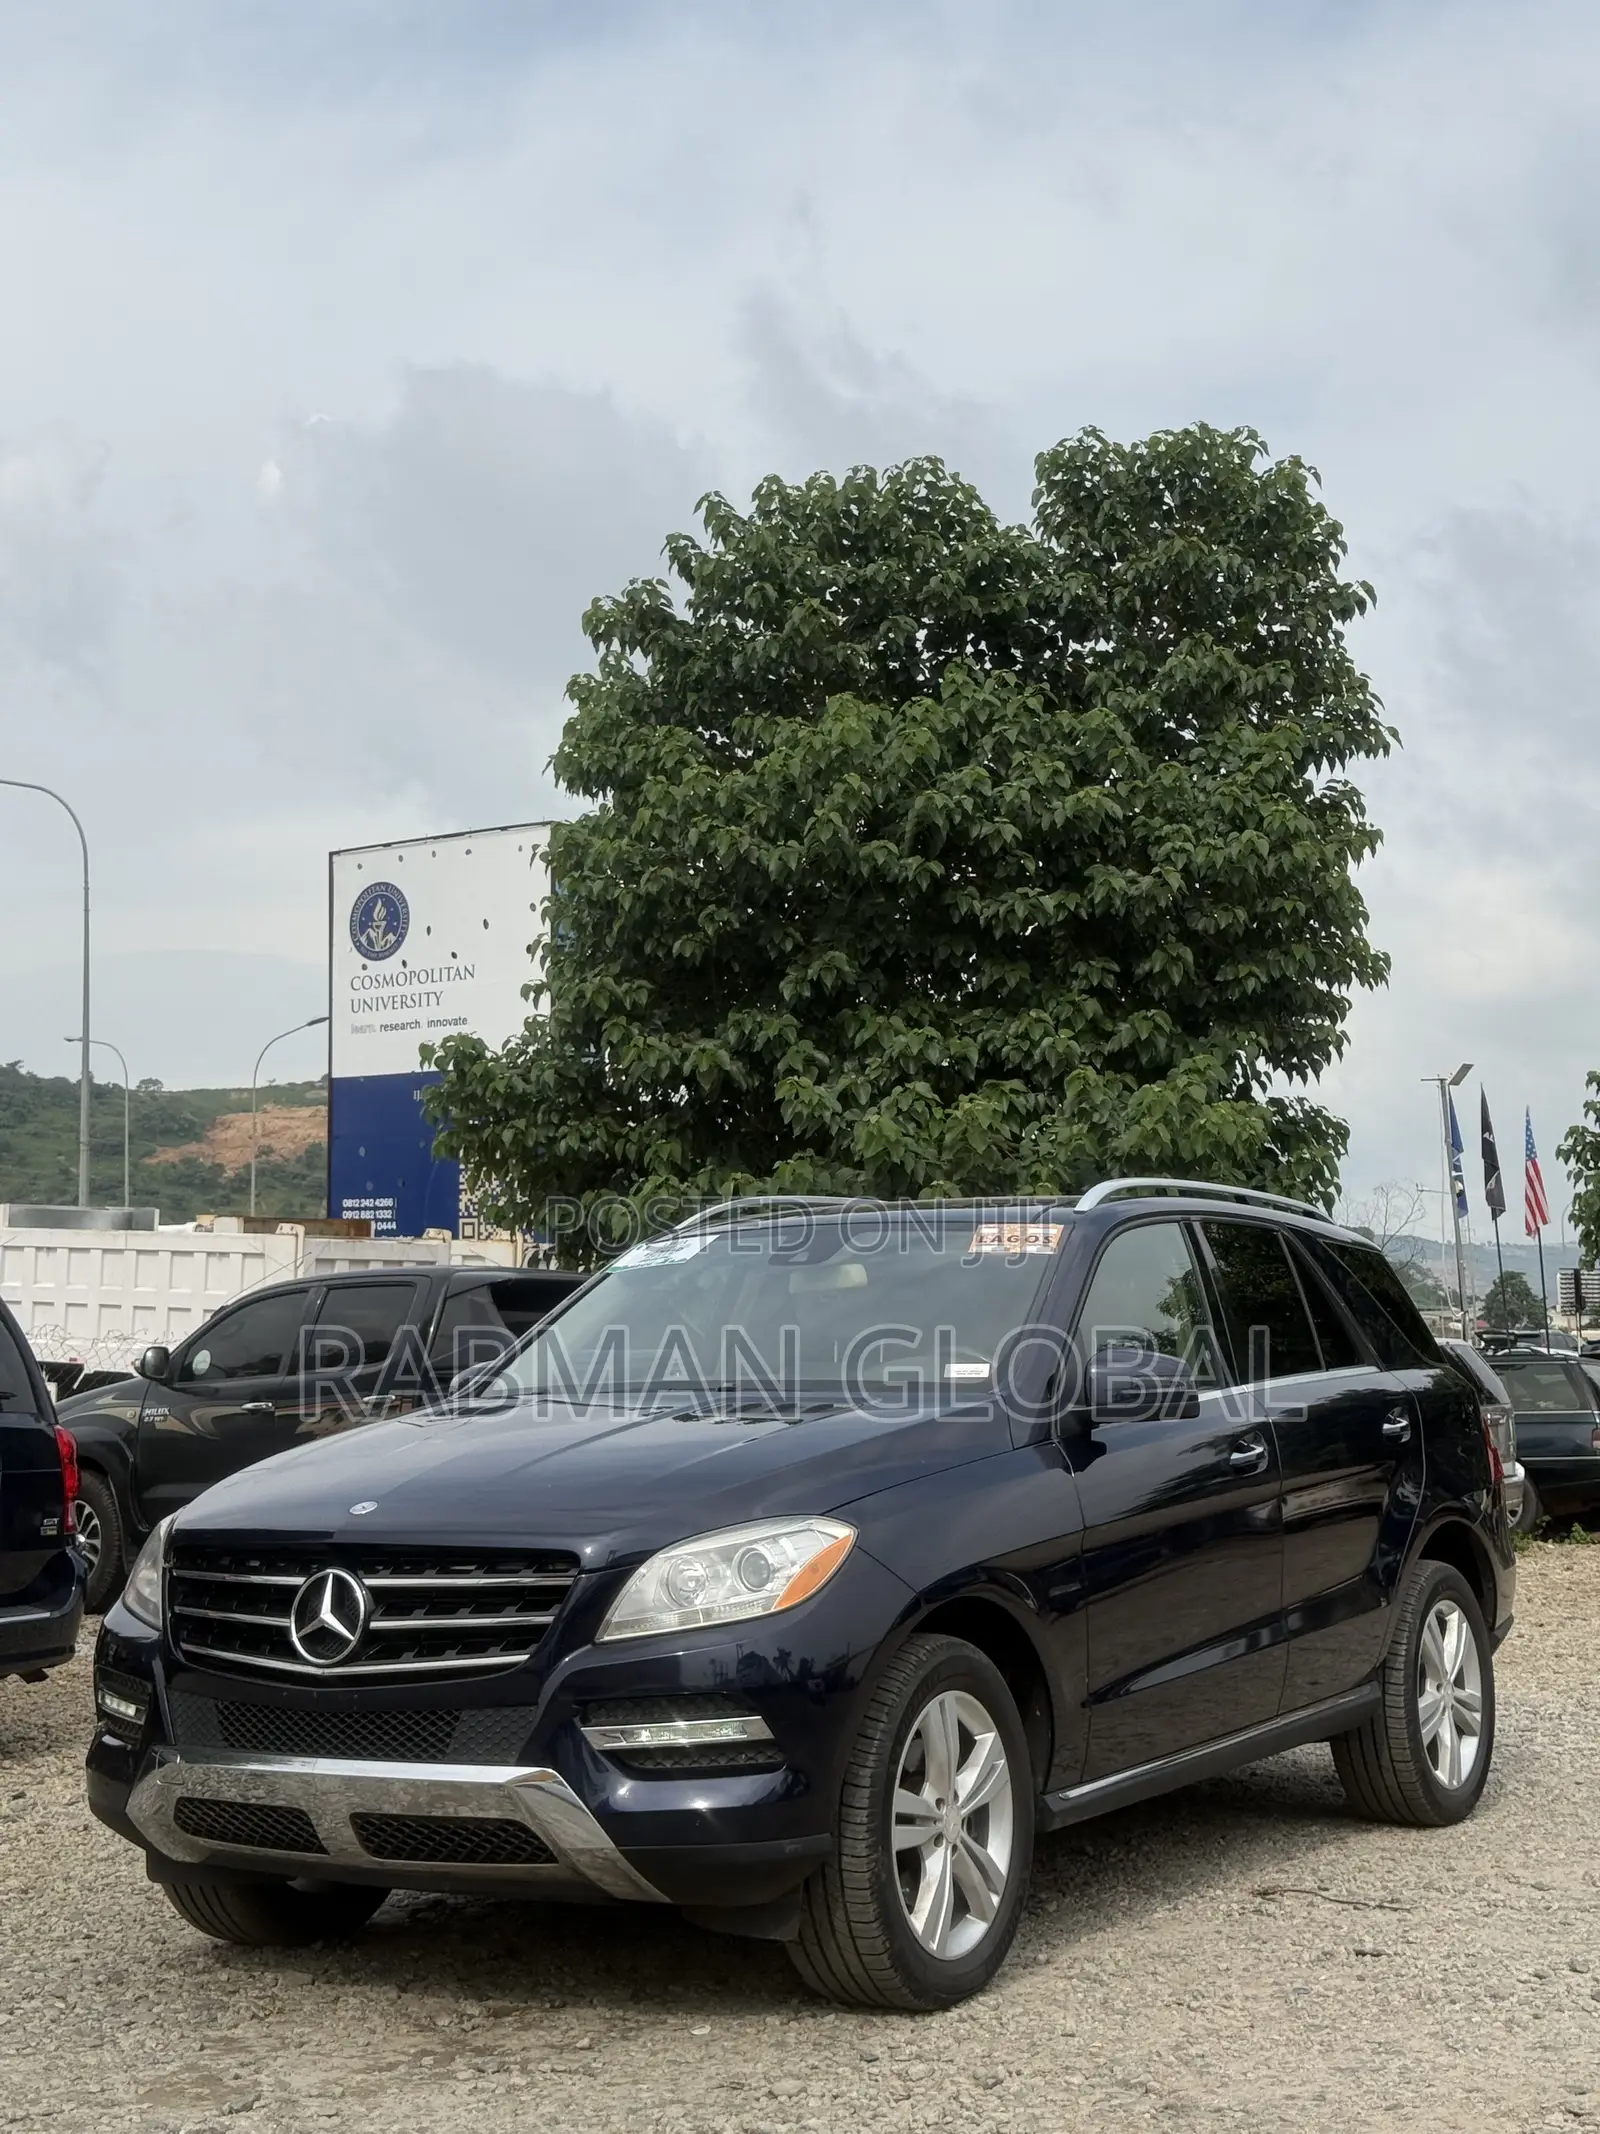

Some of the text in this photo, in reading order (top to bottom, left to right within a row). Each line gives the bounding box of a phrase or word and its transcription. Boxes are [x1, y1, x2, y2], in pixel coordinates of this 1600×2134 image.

[350, 963, 476, 992] COSMOPOLITAN
[350, 991, 444, 1014] UNIVERSITY
[977, 1234, 1055, 1245] LAGOS
